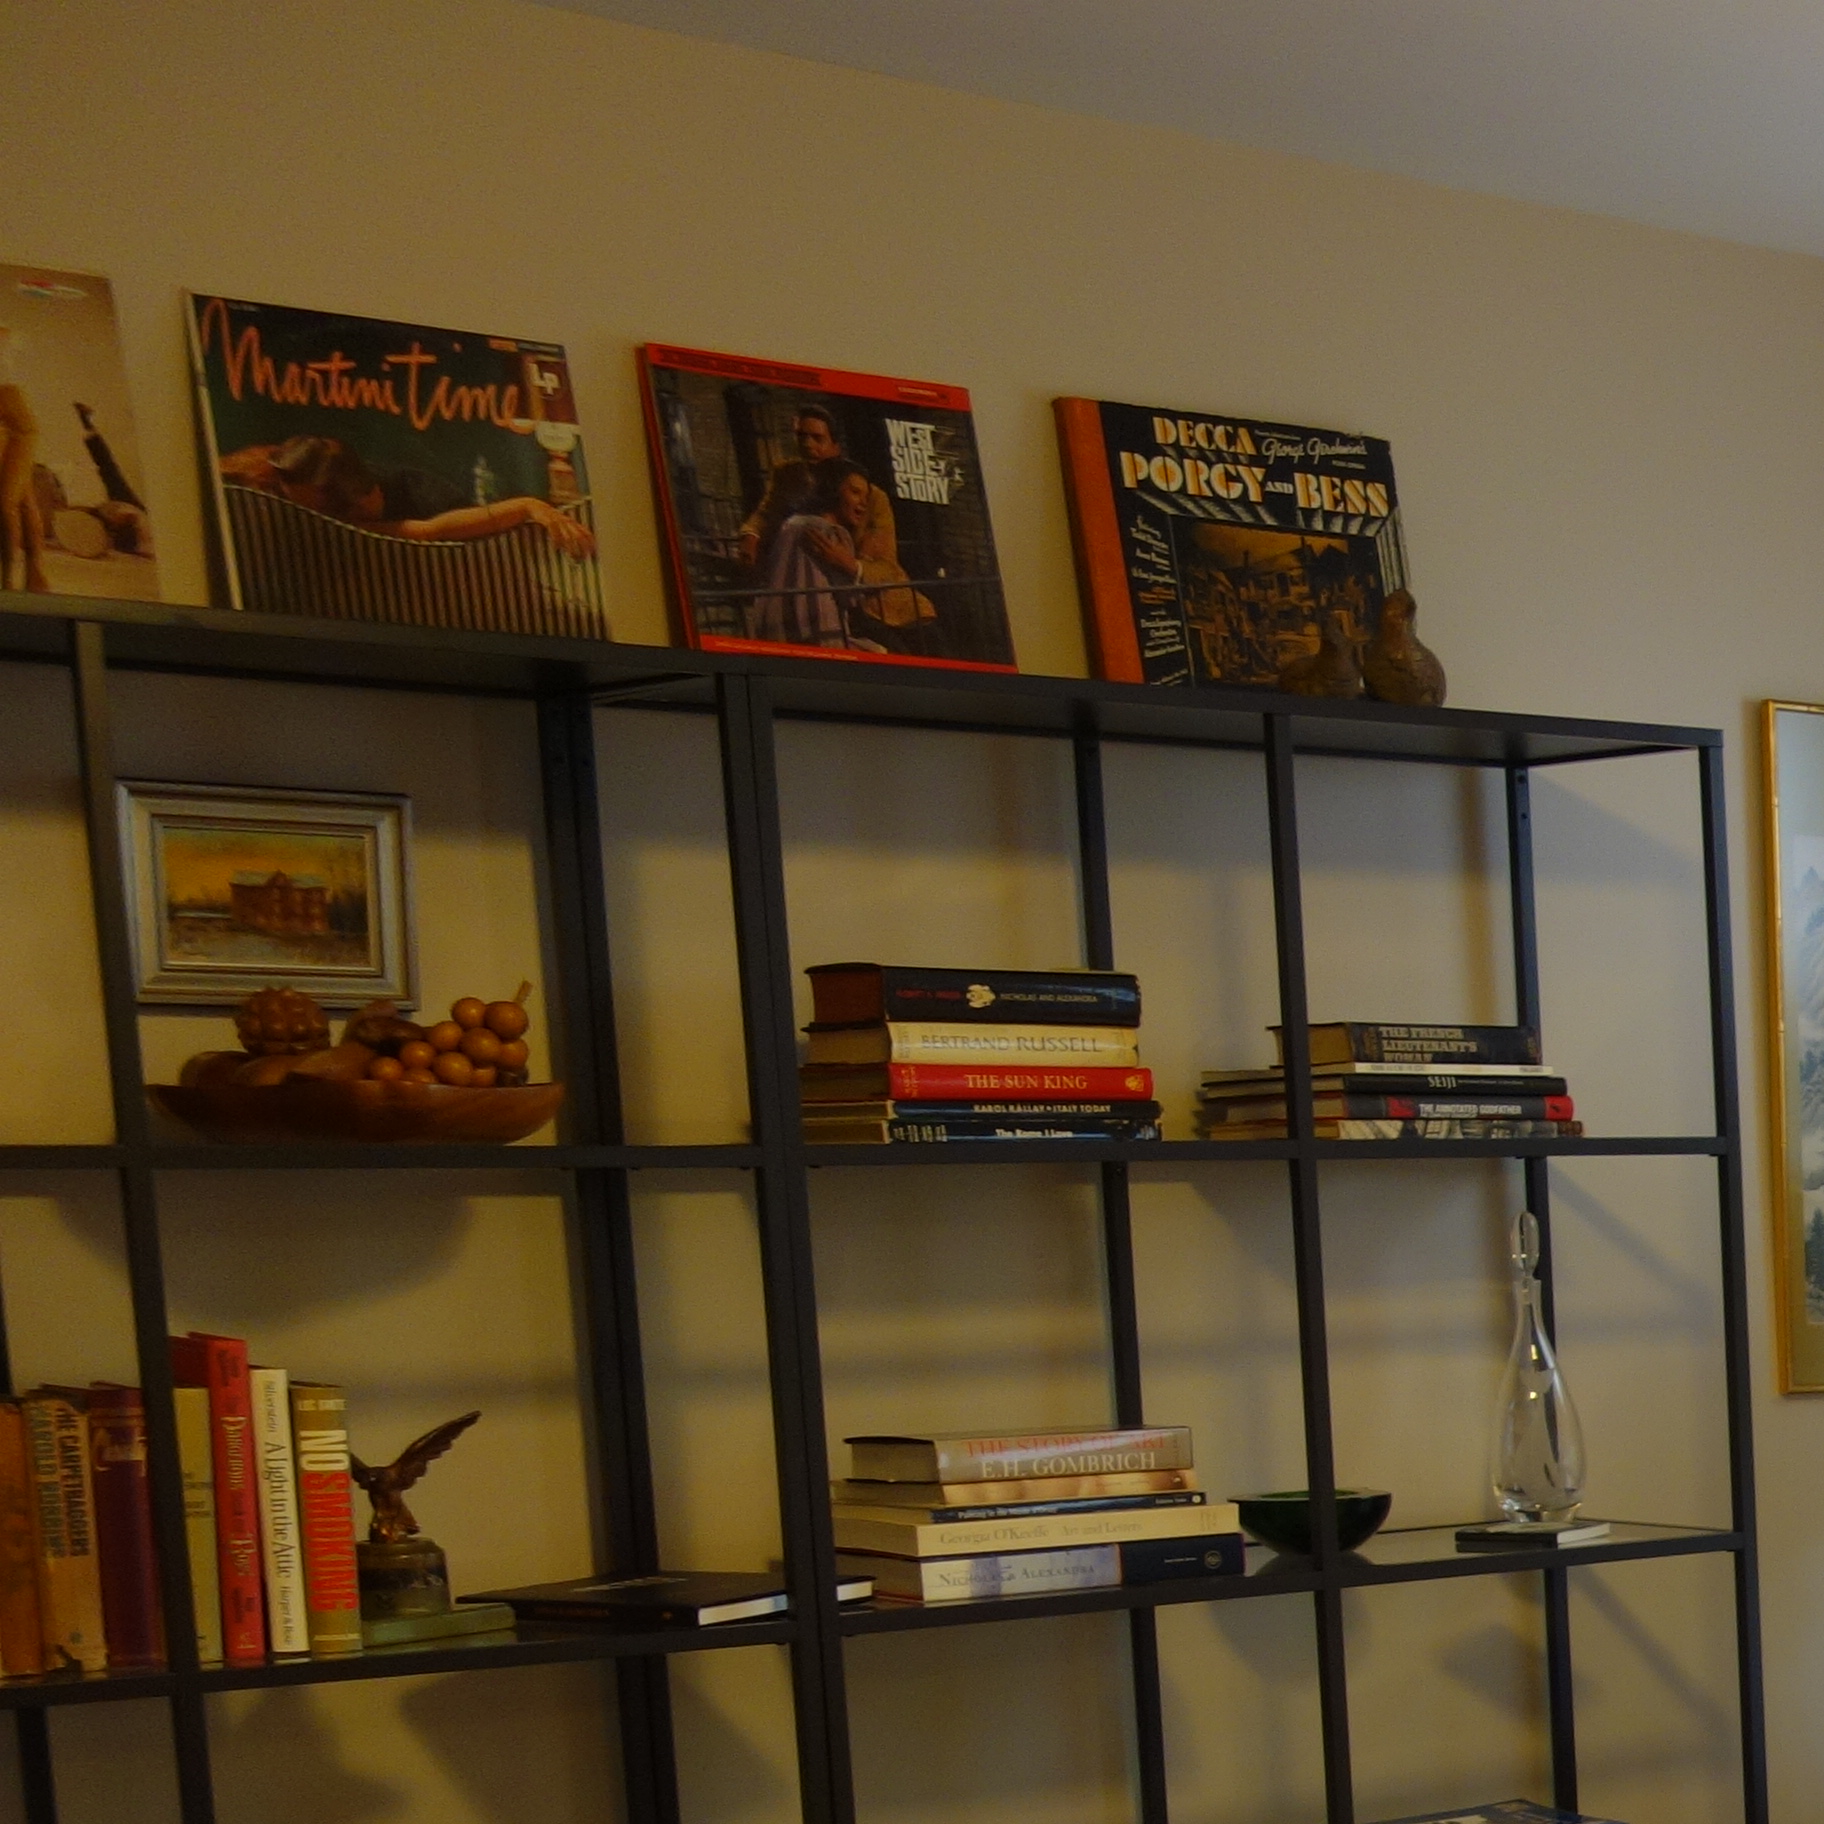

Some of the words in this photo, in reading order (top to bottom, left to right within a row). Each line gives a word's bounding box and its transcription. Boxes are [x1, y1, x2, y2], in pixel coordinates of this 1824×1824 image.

[201, 299, 402, 417] Martini
[884, 417, 937, 451] WEST
[1152, 415, 1259, 456] DECCA
[890, 446, 946, 479] SIDE
[894, 471, 951, 506] STORY
[1119, 450, 1267, 505] PORGY
[1293, 471, 1391, 520] BESS
[921, 1033, 1010, 1051] BERTRAND
[1016, 1035, 1103, 1053] RUSSELL
[965, 1074, 1000, 1089] THE
[1004, 1074, 1039, 1090] SUN
[1043, 1074, 1089, 1091] KING
[1427, 1075, 1458, 1089] SEIJI
[1080, 1103, 1112, 1114] TODAY
[264, 1441, 287, 1454] A
[299, 1429, 349, 1471] NO
[964, 1439, 1009, 1457] THE
[263, 1458, 289, 1494] Light
[981, 1459, 1029, 1479] E.H.
[1032, 1451, 1157, 1477] GOMBRICH
[270, 1498, 289, 1513] in
[272, 1516, 294, 1541] the
[302, 1472, 359, 1611] SMOKING
[939, 1532, 991, 1546] Georgia
[271, 1541, 297, 1578] Attic
